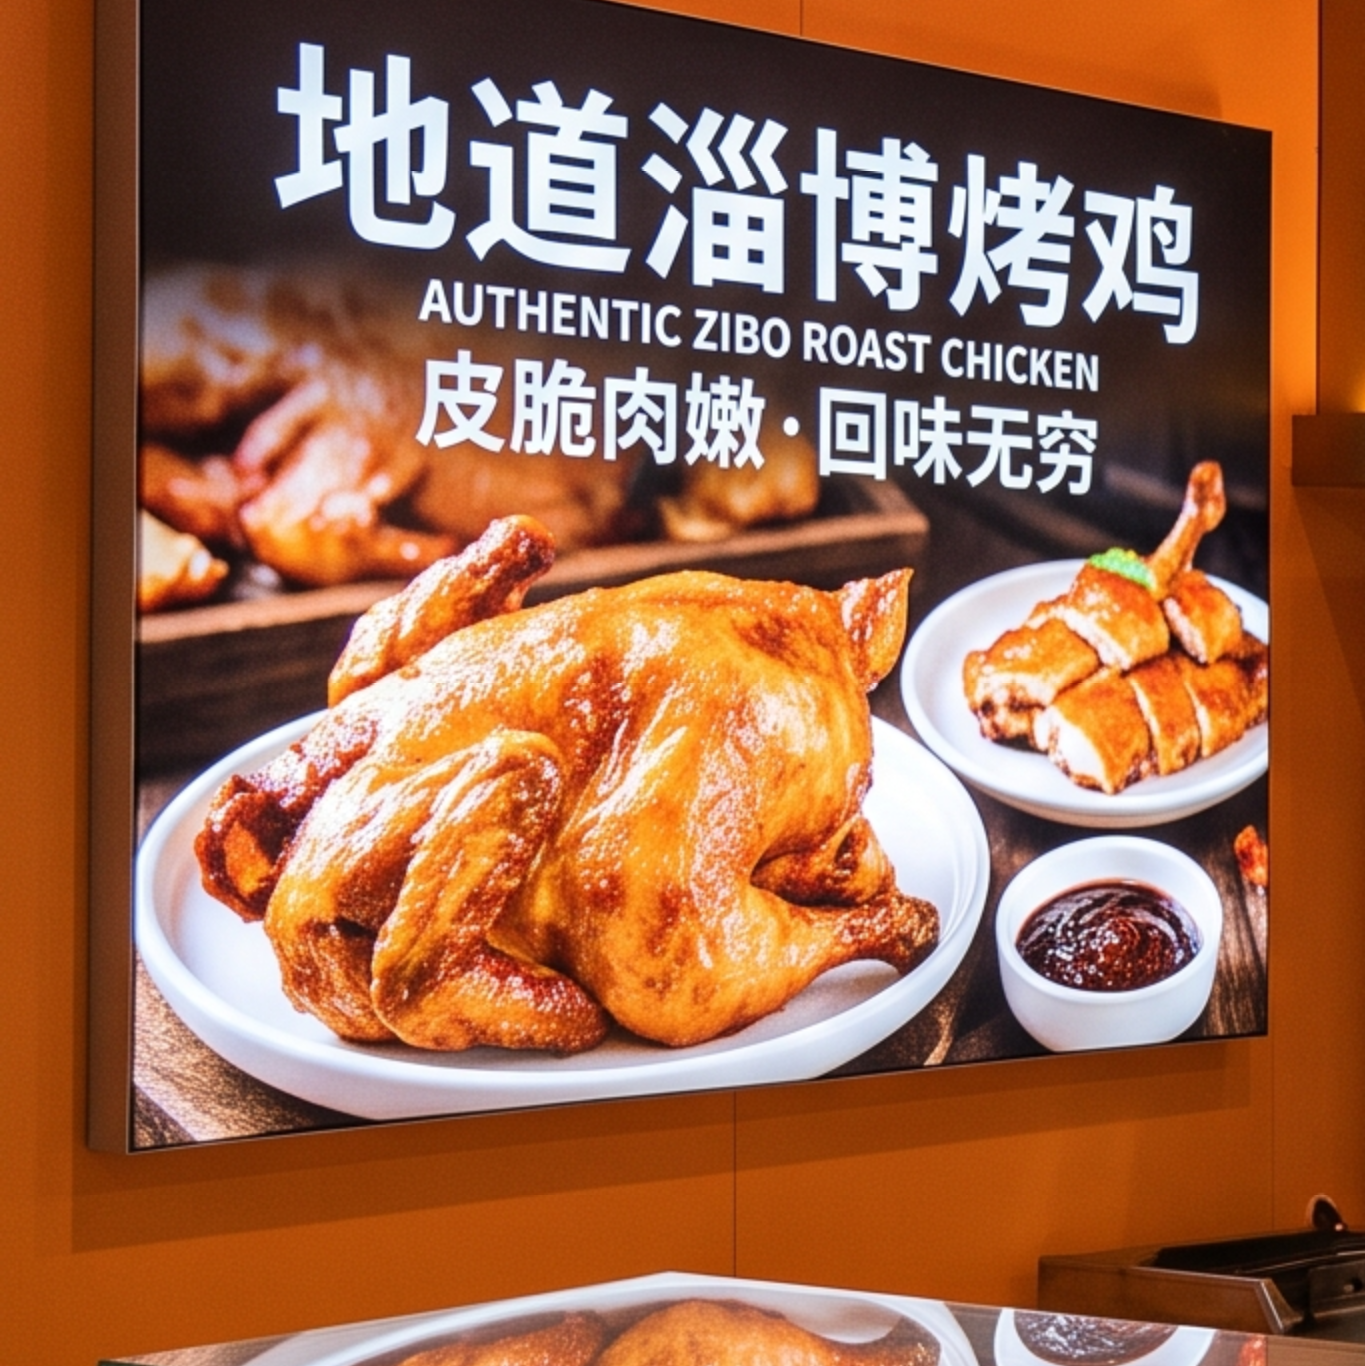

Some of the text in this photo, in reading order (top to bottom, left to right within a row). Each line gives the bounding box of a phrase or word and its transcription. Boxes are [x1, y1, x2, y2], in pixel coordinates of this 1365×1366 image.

[273, 42, 1200, 344] 地道淄博烤鸡
[418, 278, 1099, 392] AUTHENTIC ZIBO ROAST CHICKEN
